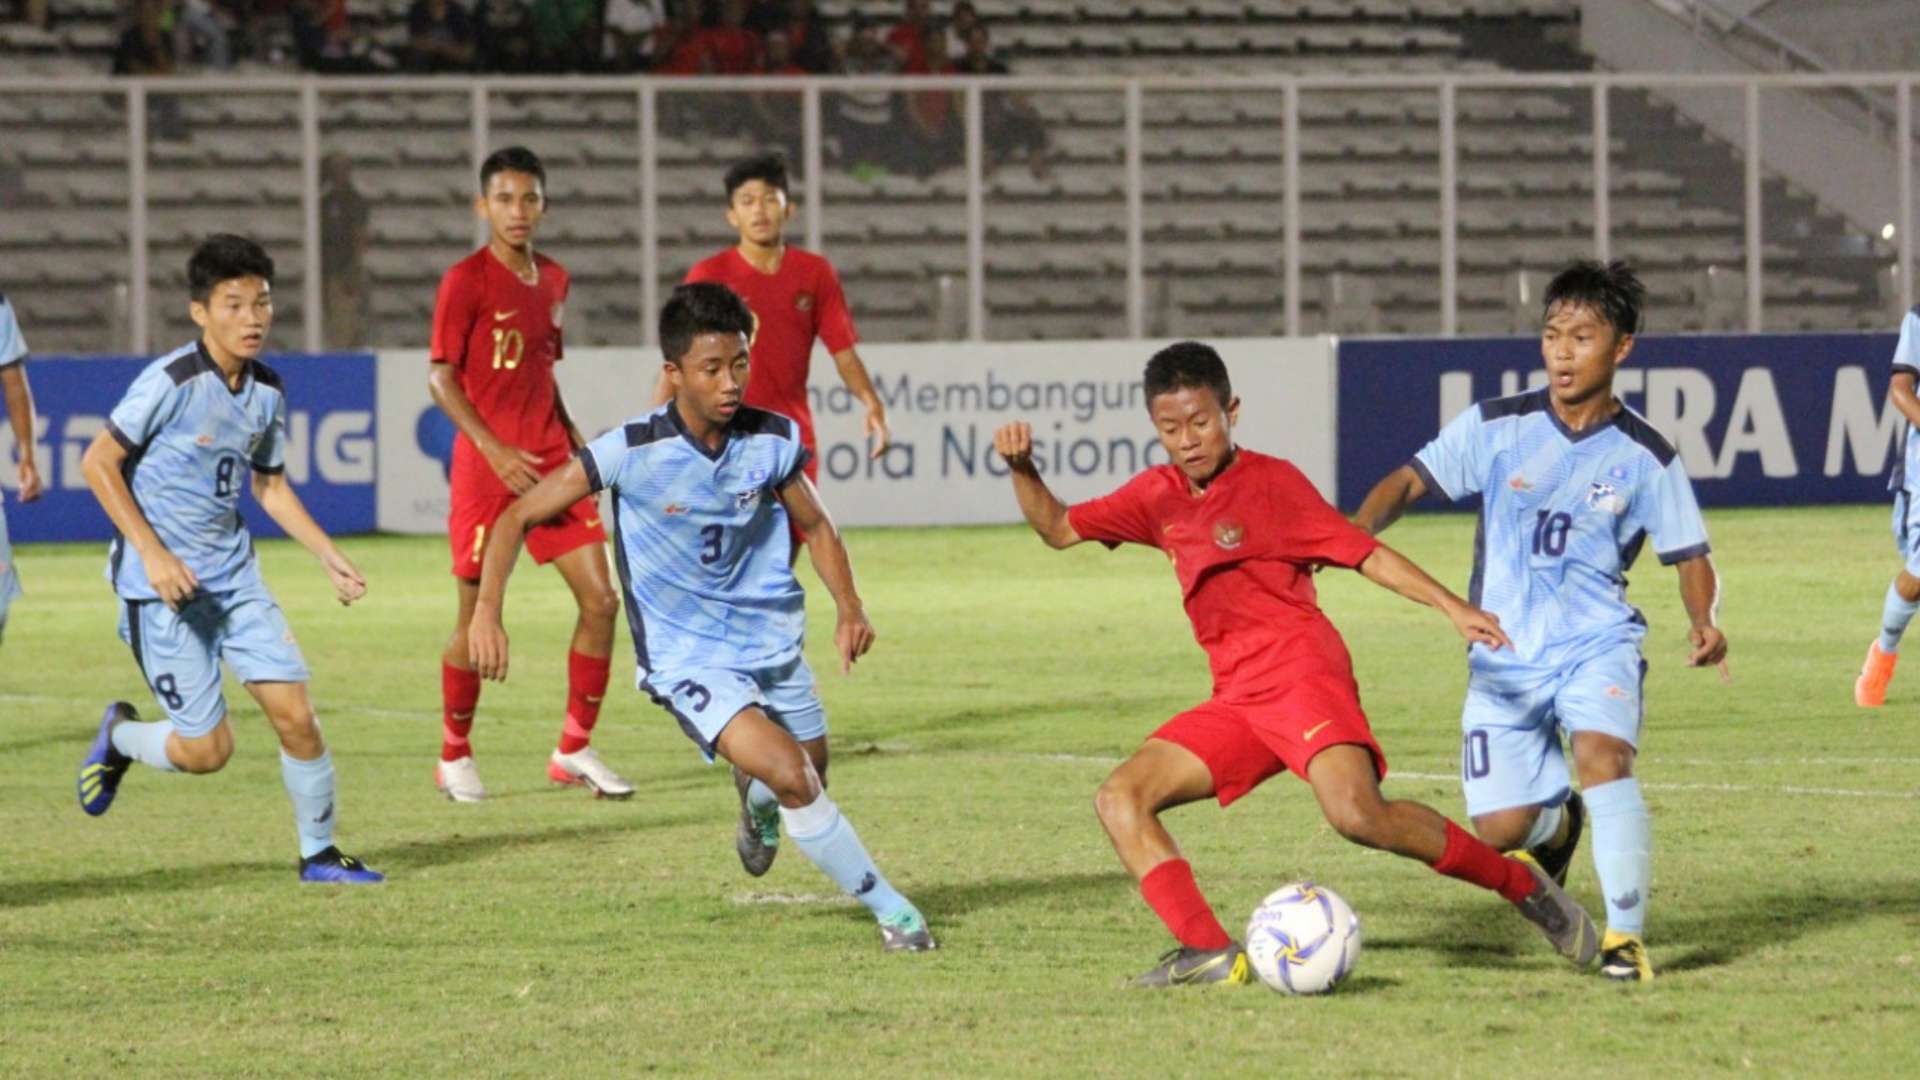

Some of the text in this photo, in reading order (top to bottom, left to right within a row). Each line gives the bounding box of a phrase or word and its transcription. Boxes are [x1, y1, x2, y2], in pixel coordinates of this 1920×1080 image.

[492, 328, 524, 369] 10
[873, 371, 1148, 423] Membangun
[826, 421, 1172, 480] ola Nasiona
[215, 456, 234, 497] 8
[472, 524, 485, 563] 1
[700, 524, 724, 565] 3
[1531, 508, 1572, 557] 10
[155, 673, 184, 710] 8
[672, 678, 711, 713] 3
[1463, 729, 1490, 781] 10
